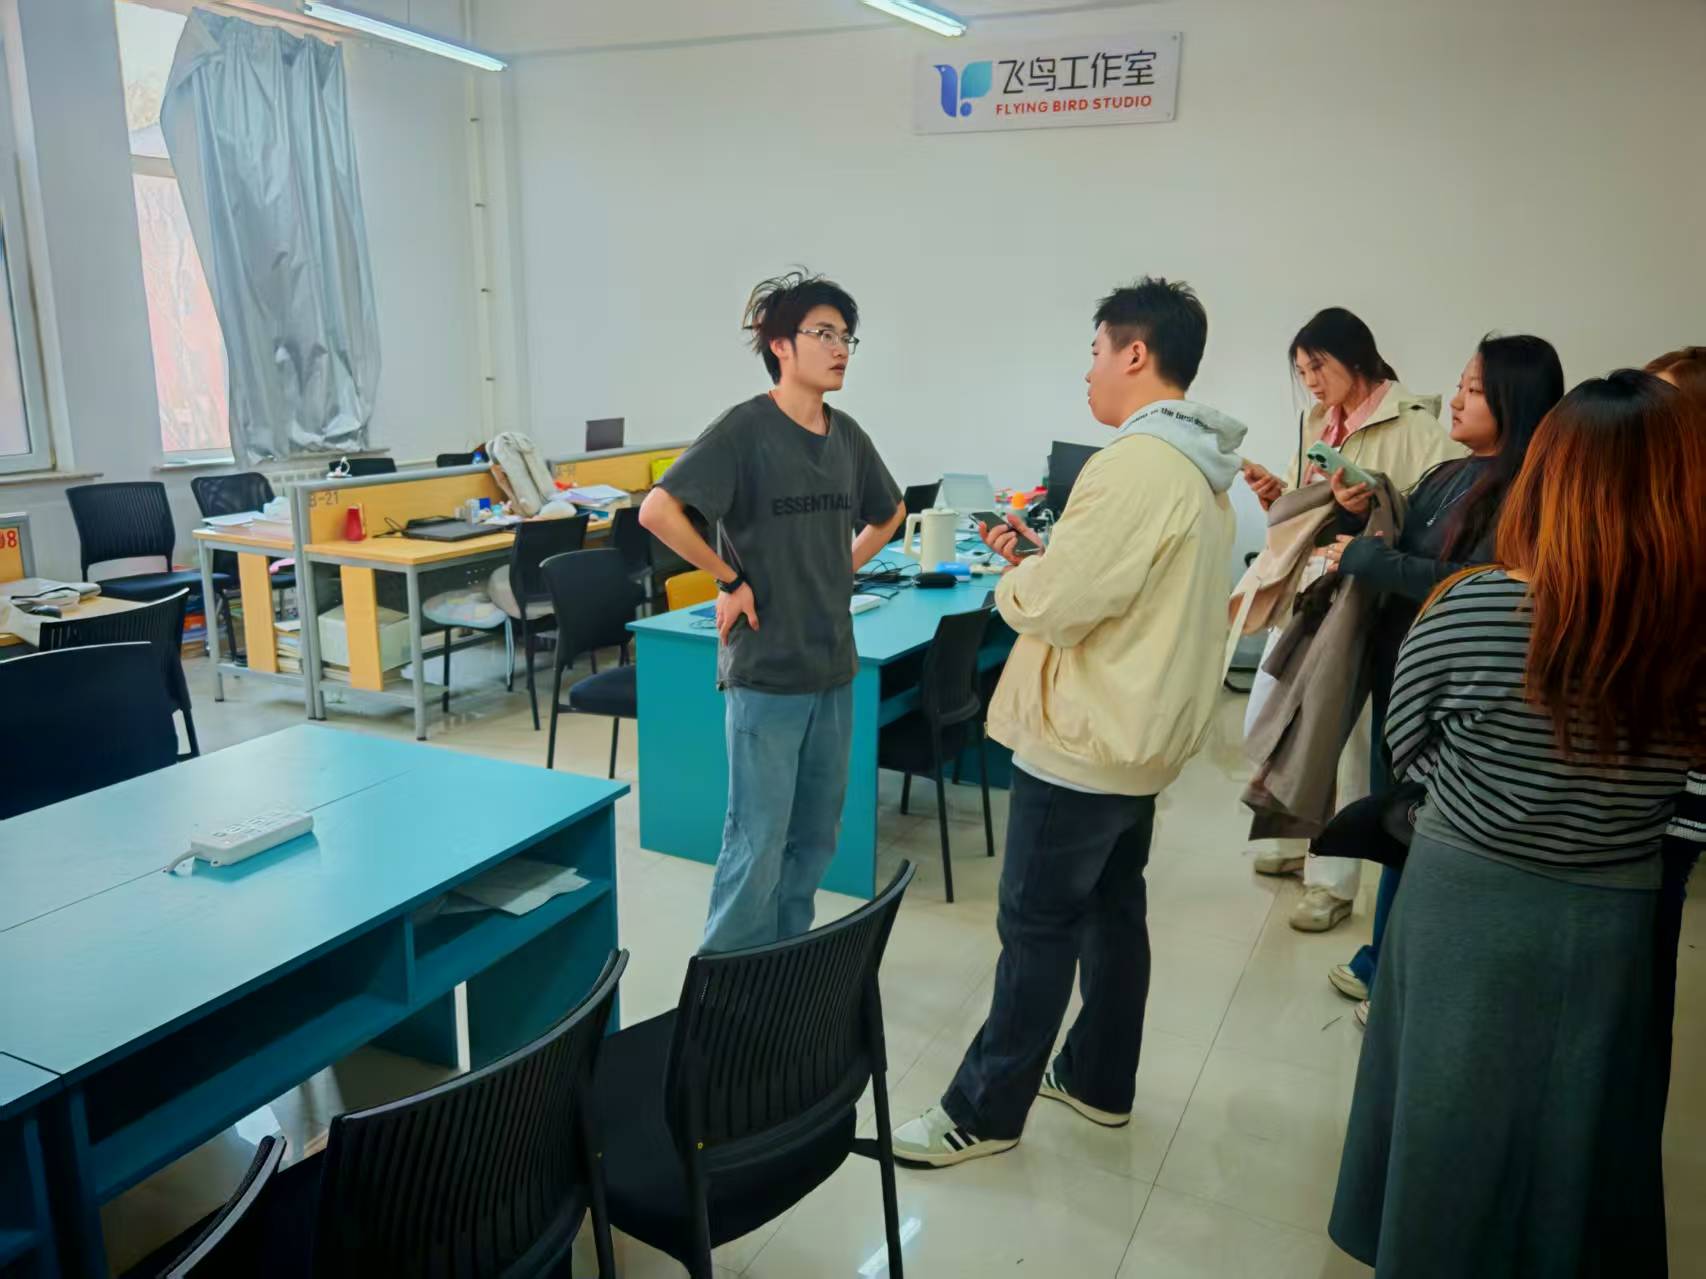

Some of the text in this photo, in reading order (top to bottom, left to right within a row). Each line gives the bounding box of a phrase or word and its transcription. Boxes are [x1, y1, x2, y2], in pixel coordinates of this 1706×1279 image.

[998, 50, 1157, 94] 飞鸟工作室
[996, 95, 1153, 116] FLYING BIRD STUDIO
